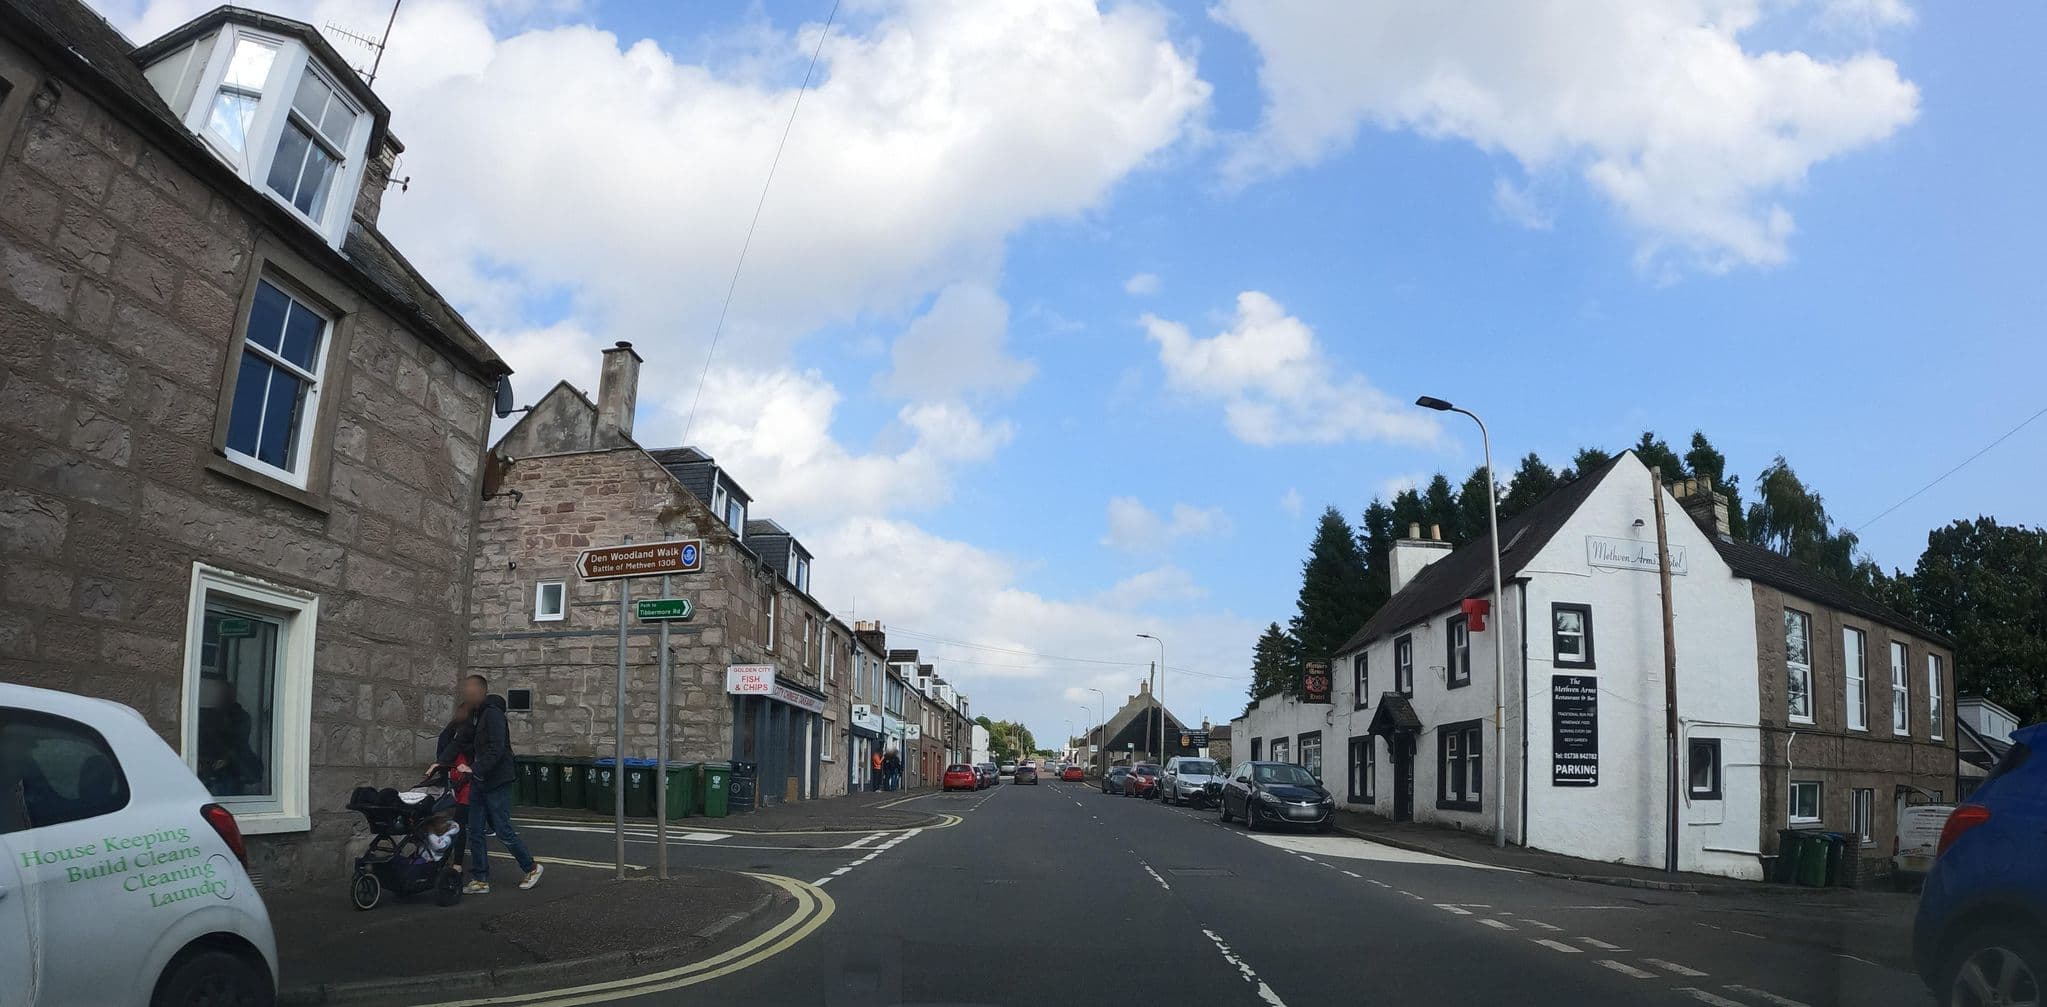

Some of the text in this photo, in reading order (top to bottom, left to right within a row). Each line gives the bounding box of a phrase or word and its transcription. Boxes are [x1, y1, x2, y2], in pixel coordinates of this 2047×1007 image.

[591, 548, 679, 563] Den Woodland Walk
[625, 561, 656, 570] Methven
[658, 559, 676, 567] 1306
[1592, 541, 1630, 561] Methven
[1631, 546, 1656, 564] Arms
[1555, 764, 1596, 774] PARKING
[20, 827, 190, 868] House Keeping
[66, 844, 200, 884] Build Cleans
[122, 862, 216, 892] Cleaning
[150, 877, 228, 908] Laundry
